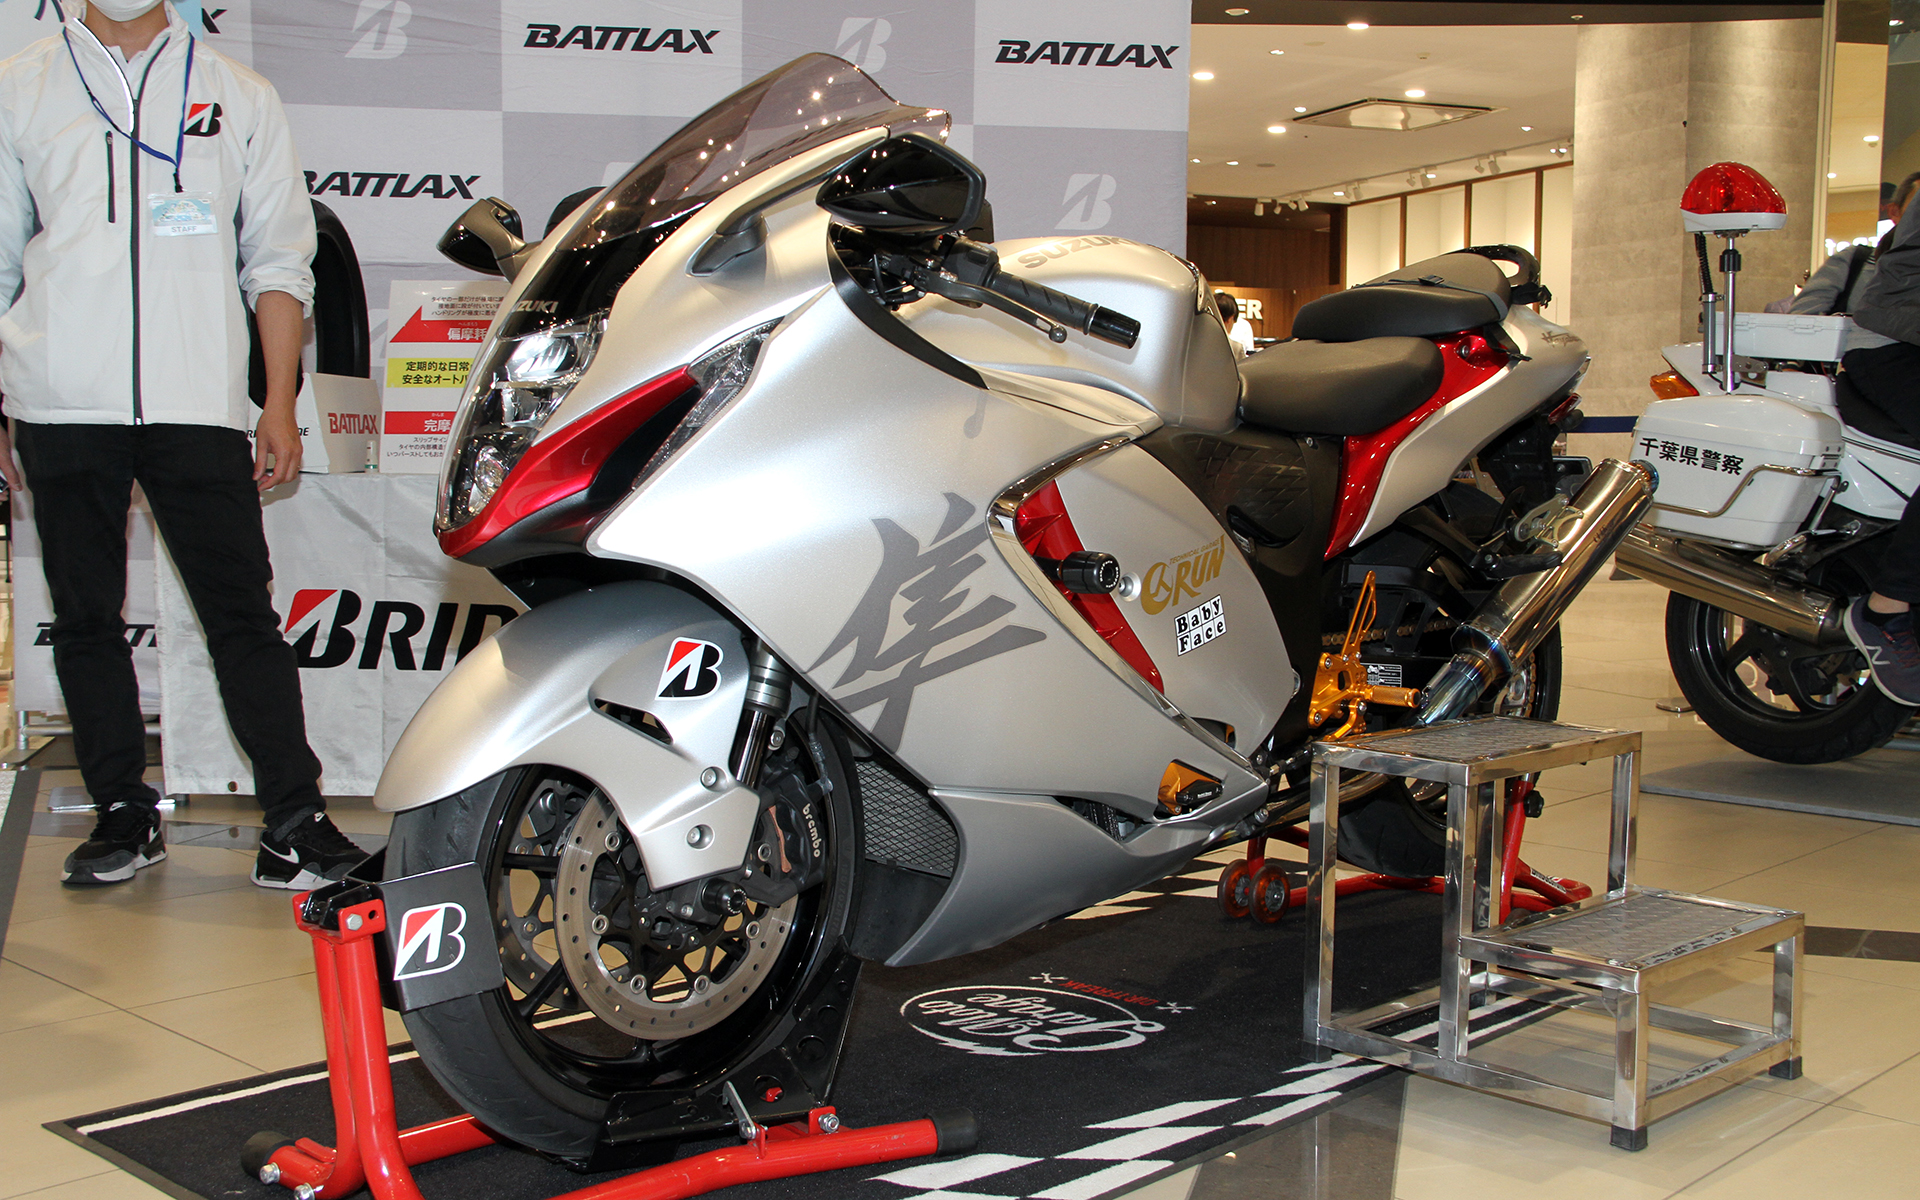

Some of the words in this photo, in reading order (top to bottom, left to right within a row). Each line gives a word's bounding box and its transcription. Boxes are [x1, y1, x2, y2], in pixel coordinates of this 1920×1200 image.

[524, 23, 720, 54] BATTLAX
[995, 39, 1180, 69] BATTLAX
[516, 299, 559, 313] ZUKI
[1235, 298, 1263, 319] ER
[405, 361, 472, 372] 定期的な日常
[328, 412, 379, 434] BATTLAX
[1640, 437, 1744, 476] 千葉県警察
[1176, 598, 1221, 634] Baby
[1179, 619, 1224, 653] Face
[802, 803, 822, 858] brembo
